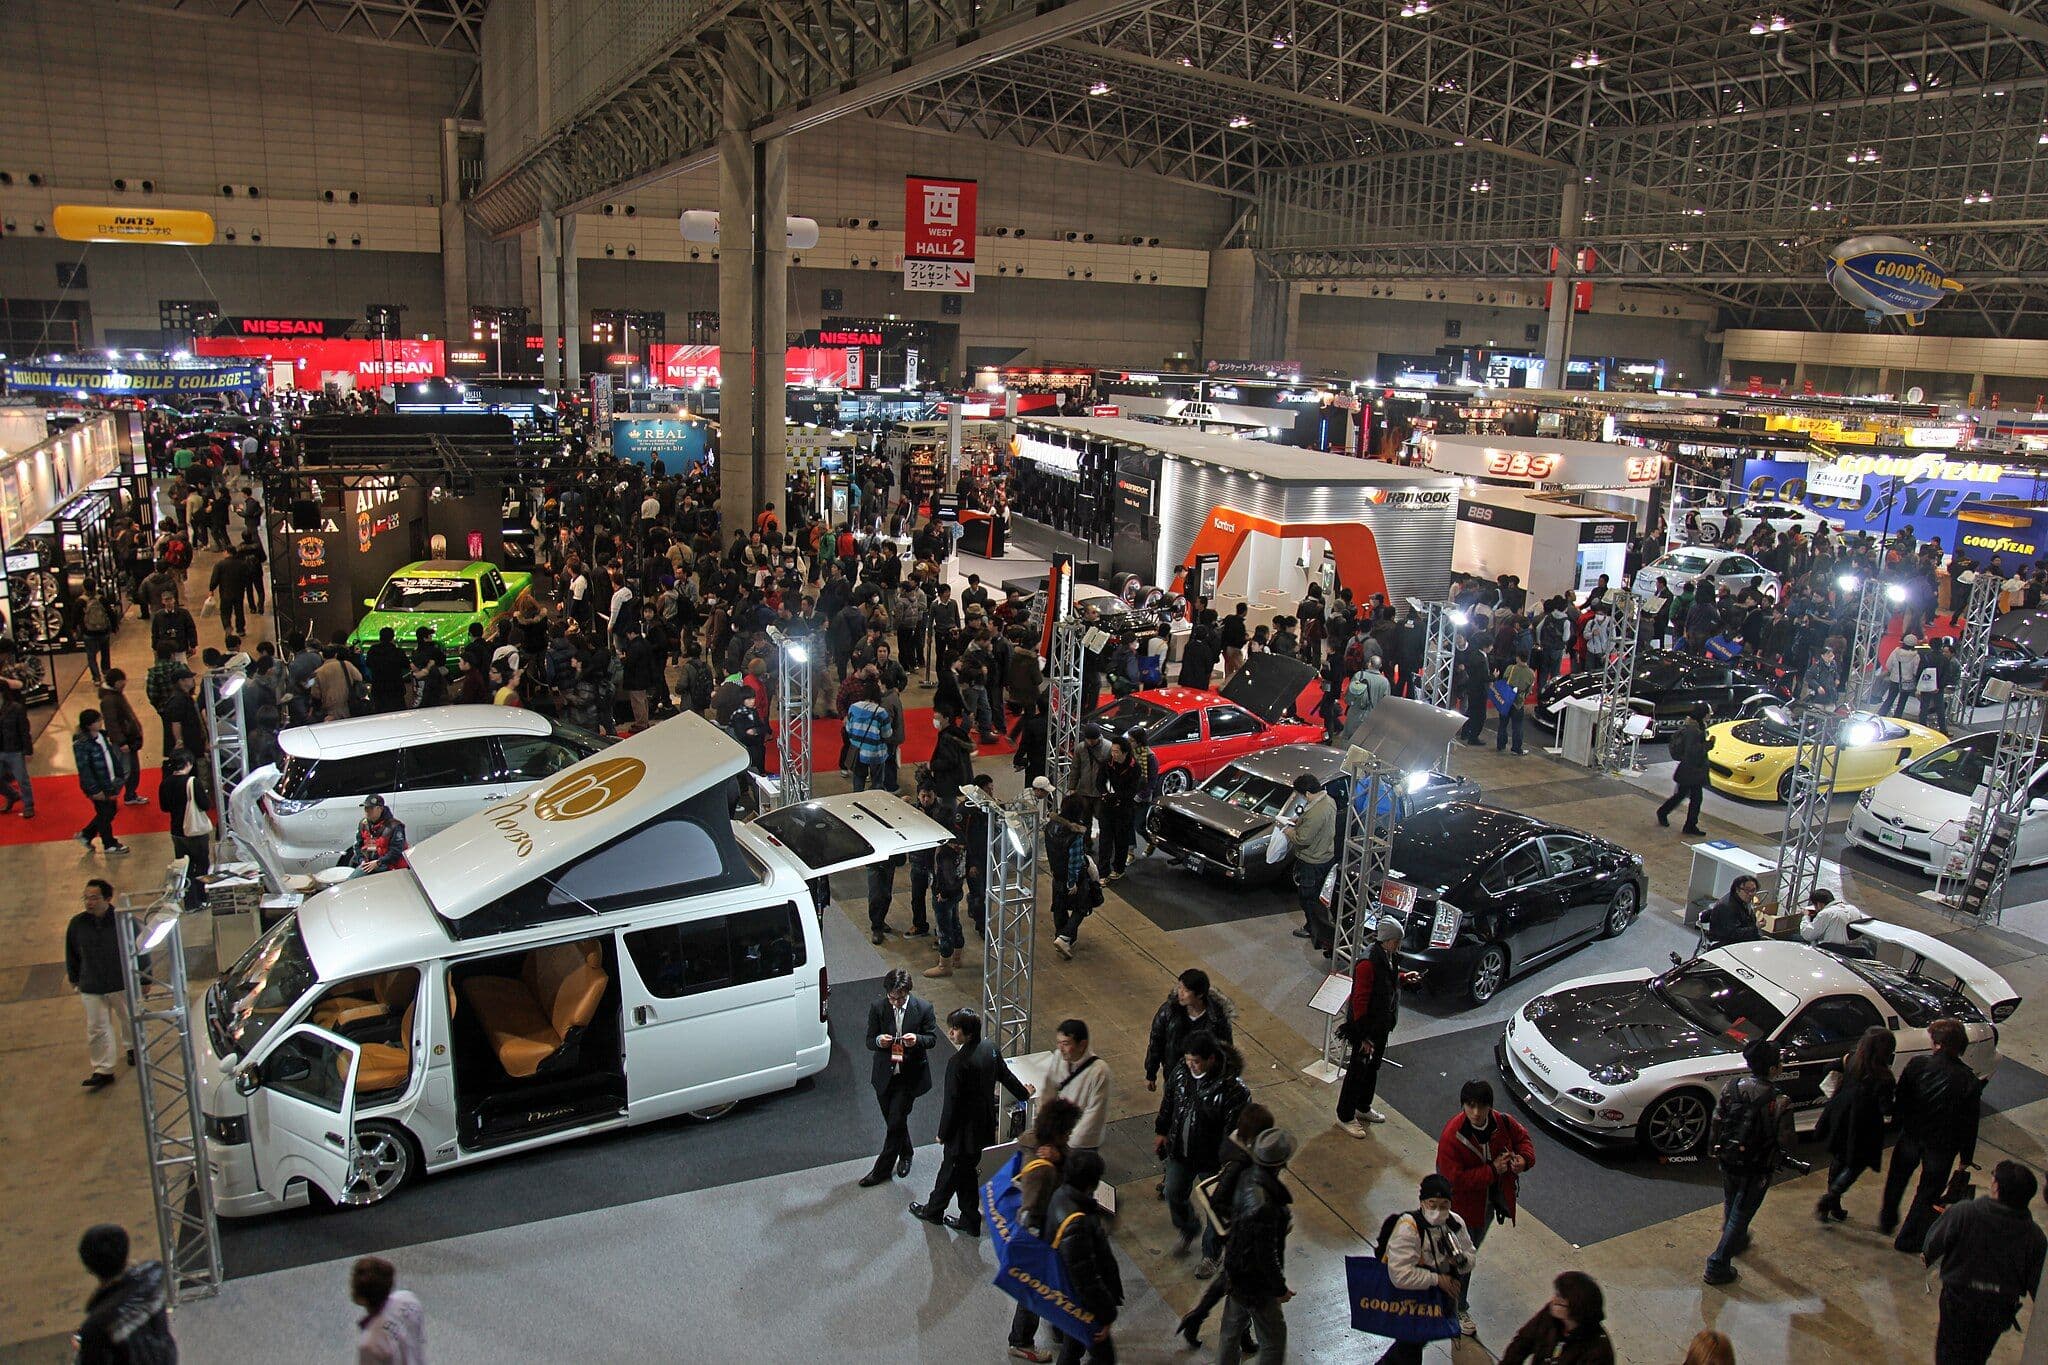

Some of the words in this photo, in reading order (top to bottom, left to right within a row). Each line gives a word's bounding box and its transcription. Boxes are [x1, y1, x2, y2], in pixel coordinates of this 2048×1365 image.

[922, 185, 960, 227] 西
[114, 216, 155, 225] NATS
[928, 227, 953, 237] WEST
[916, 241, 951, 255] HALL
[952, 238, 965, 256] 2
[910, 262, 951, 271] アンケート
[910, 271, 951, 281] プレゼント
[1875, 259, 1942, 291] GOODYEAR
[910, 280, 945, 288] コーナー
[243, 319, 325, 335] NISSAN
[819, 331, 883, 345] NISSAN
[359, 360, 434, 375] NISSAN
[667, 365, 720, 378] NISSA
[13, 370, 52, 386] NIHON
[55, 372, 175, 390] AUTOMOBILE
[179, 370, 243, 389] COLLEGE
[645, 429, 687, 439] REAL
[1488, 453, 1553, 479] BBS
[1627, 456, 1658, 482] BBS
[1836, 452, 2004, 485] GOODYEAR
[1467, 506, 1494, 521] BBS
[280, 518, 340, 534] AA
[1594, 525, 1615, 535] BBS
[1963, 534, 2037, 556] GOODYEAR
[1529, 1052, 1552, 1076] YOKOHAMA
[1667, 1155, 1698, 1163] YOKOHAMA
[1008, 1266, 1097, 1325] GOODYEAR
[1359, 1297, 1443, 1318] GOODYEAR
